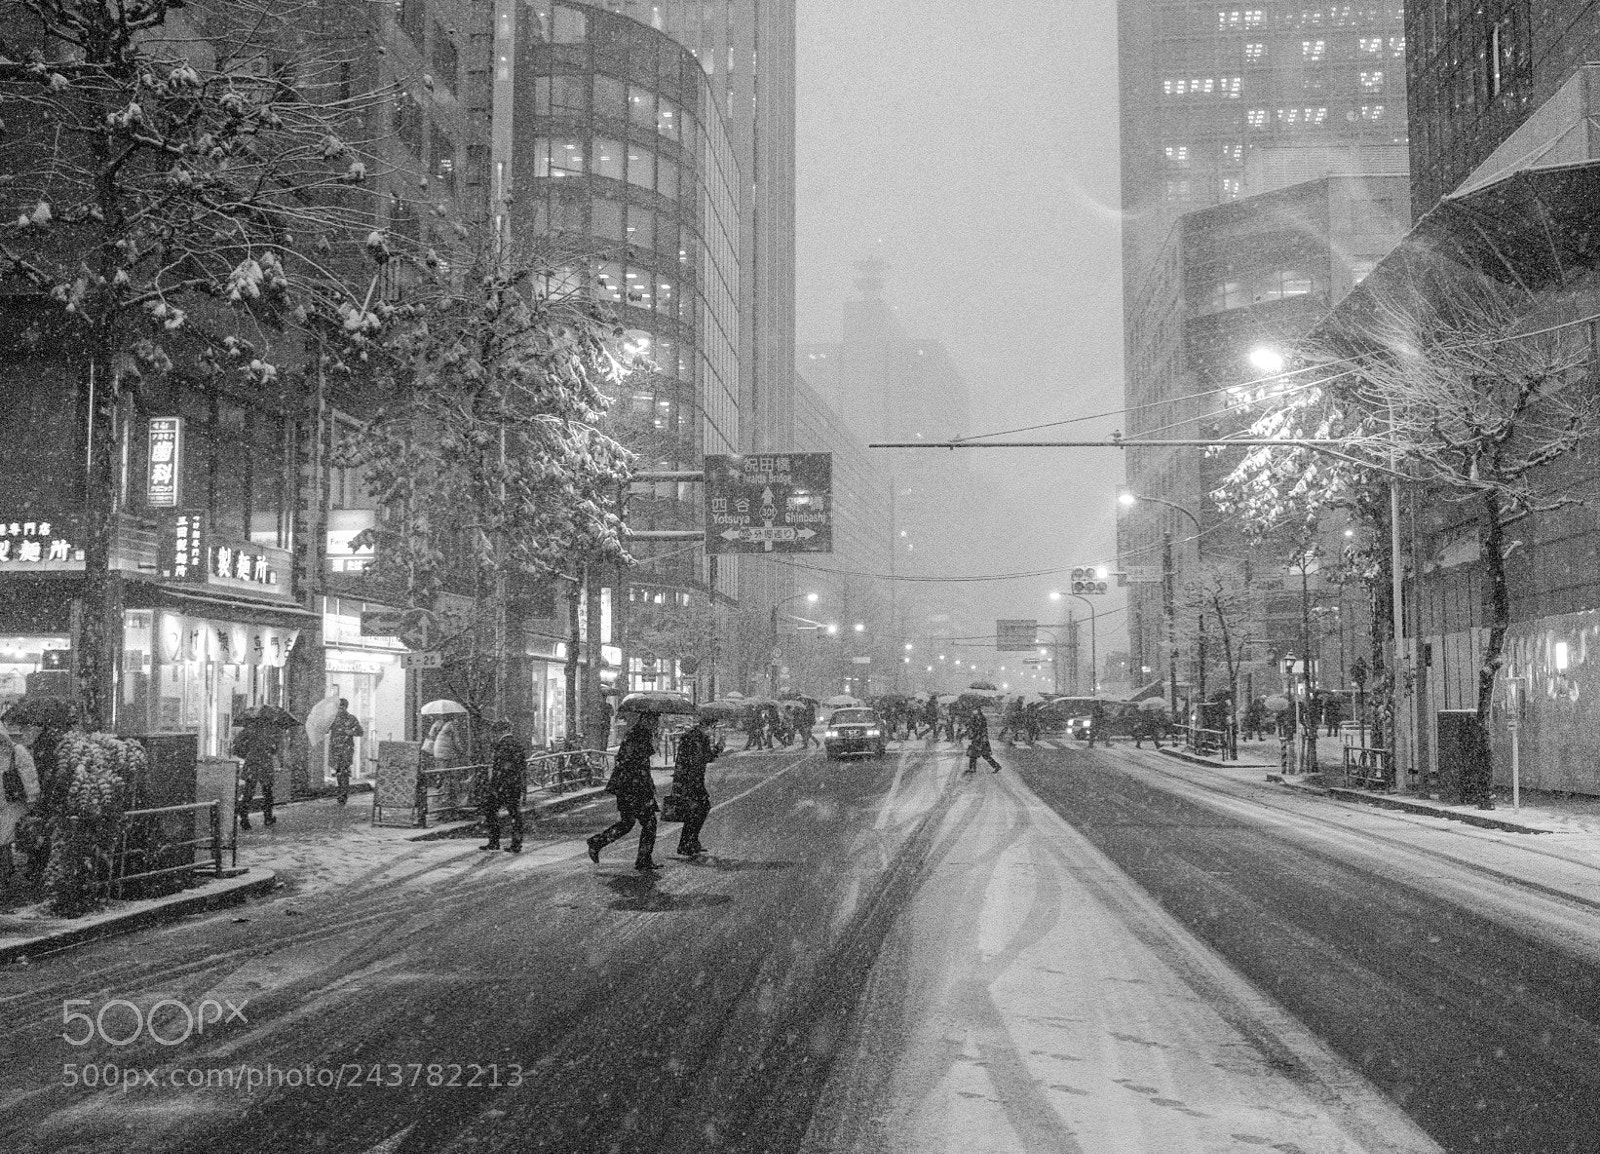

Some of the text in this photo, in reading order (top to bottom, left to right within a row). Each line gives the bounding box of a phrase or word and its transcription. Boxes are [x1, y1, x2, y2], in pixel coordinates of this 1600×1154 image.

[151, 441, 174, 484] 歯科
[744, 457, 791, 472] 祝田橋
[711, 498, 751, 513] 四谷
[712, 513, 751, 526] Yotsuya
[784, 512, 826, 524] Shinbashi
[217, 546, 269, 584] 製麺所
